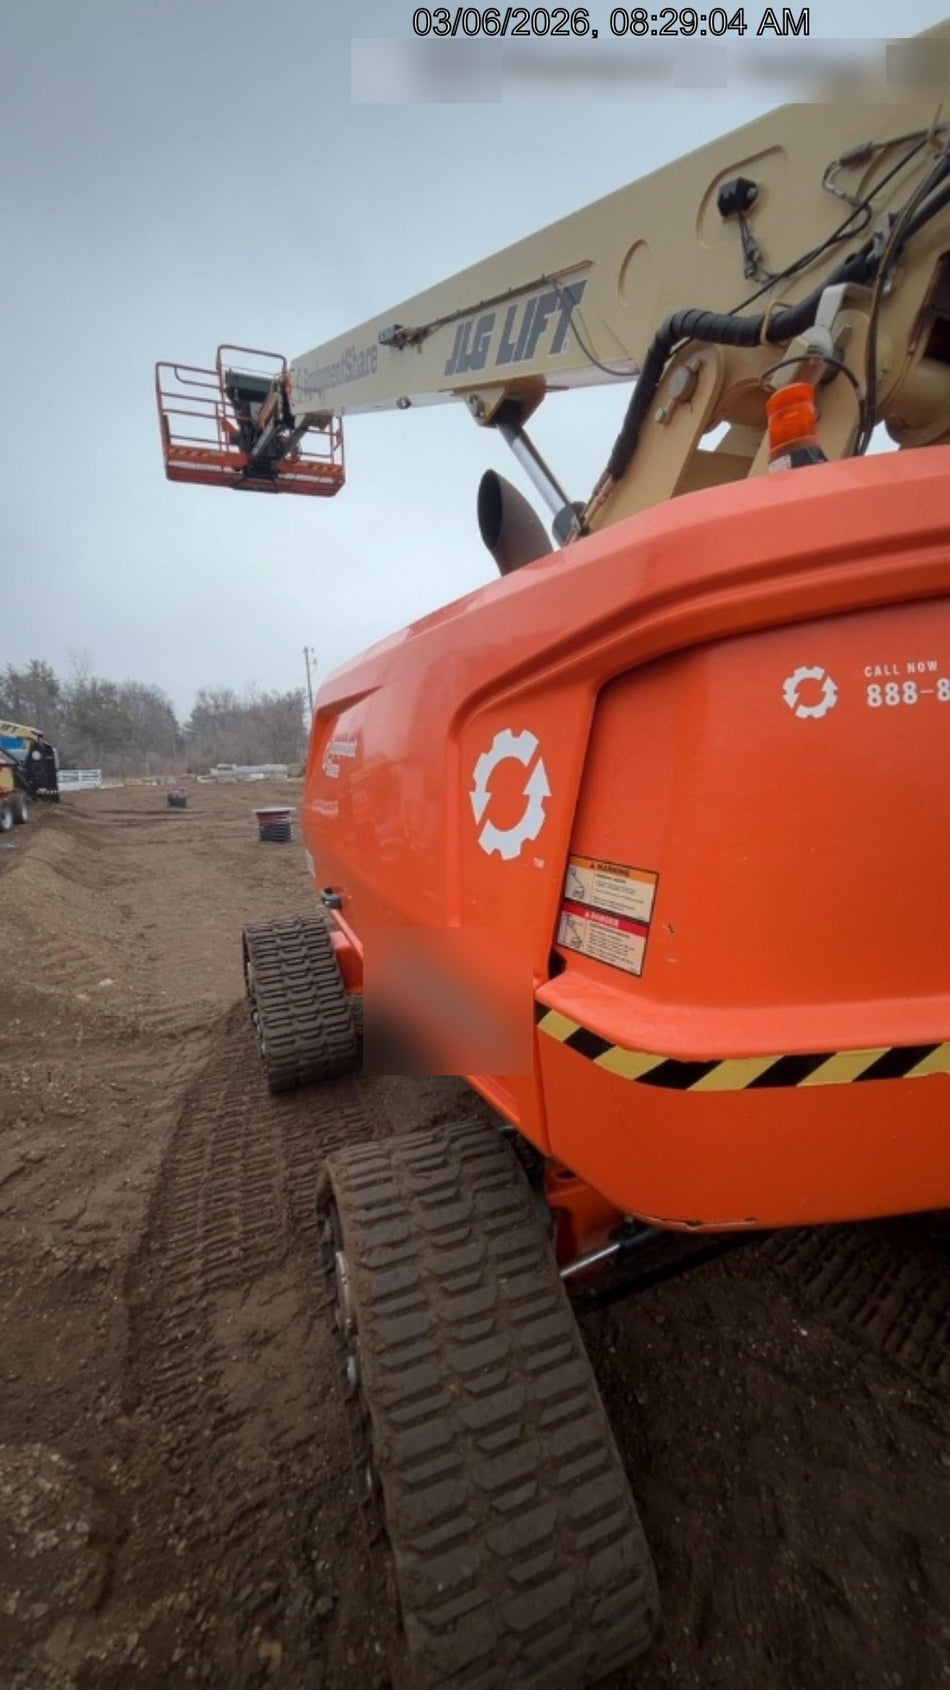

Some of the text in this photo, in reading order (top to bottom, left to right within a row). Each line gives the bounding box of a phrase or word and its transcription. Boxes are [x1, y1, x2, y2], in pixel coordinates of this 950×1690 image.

[444, 279, 588, 377] JLG LIFT
[864, 660, 938, 677] CALL NOW
[867, 678, 950, 707] 888-8
[596, 863, 631, 878] WARNING
[589, 911, 620, 928] DANGER
